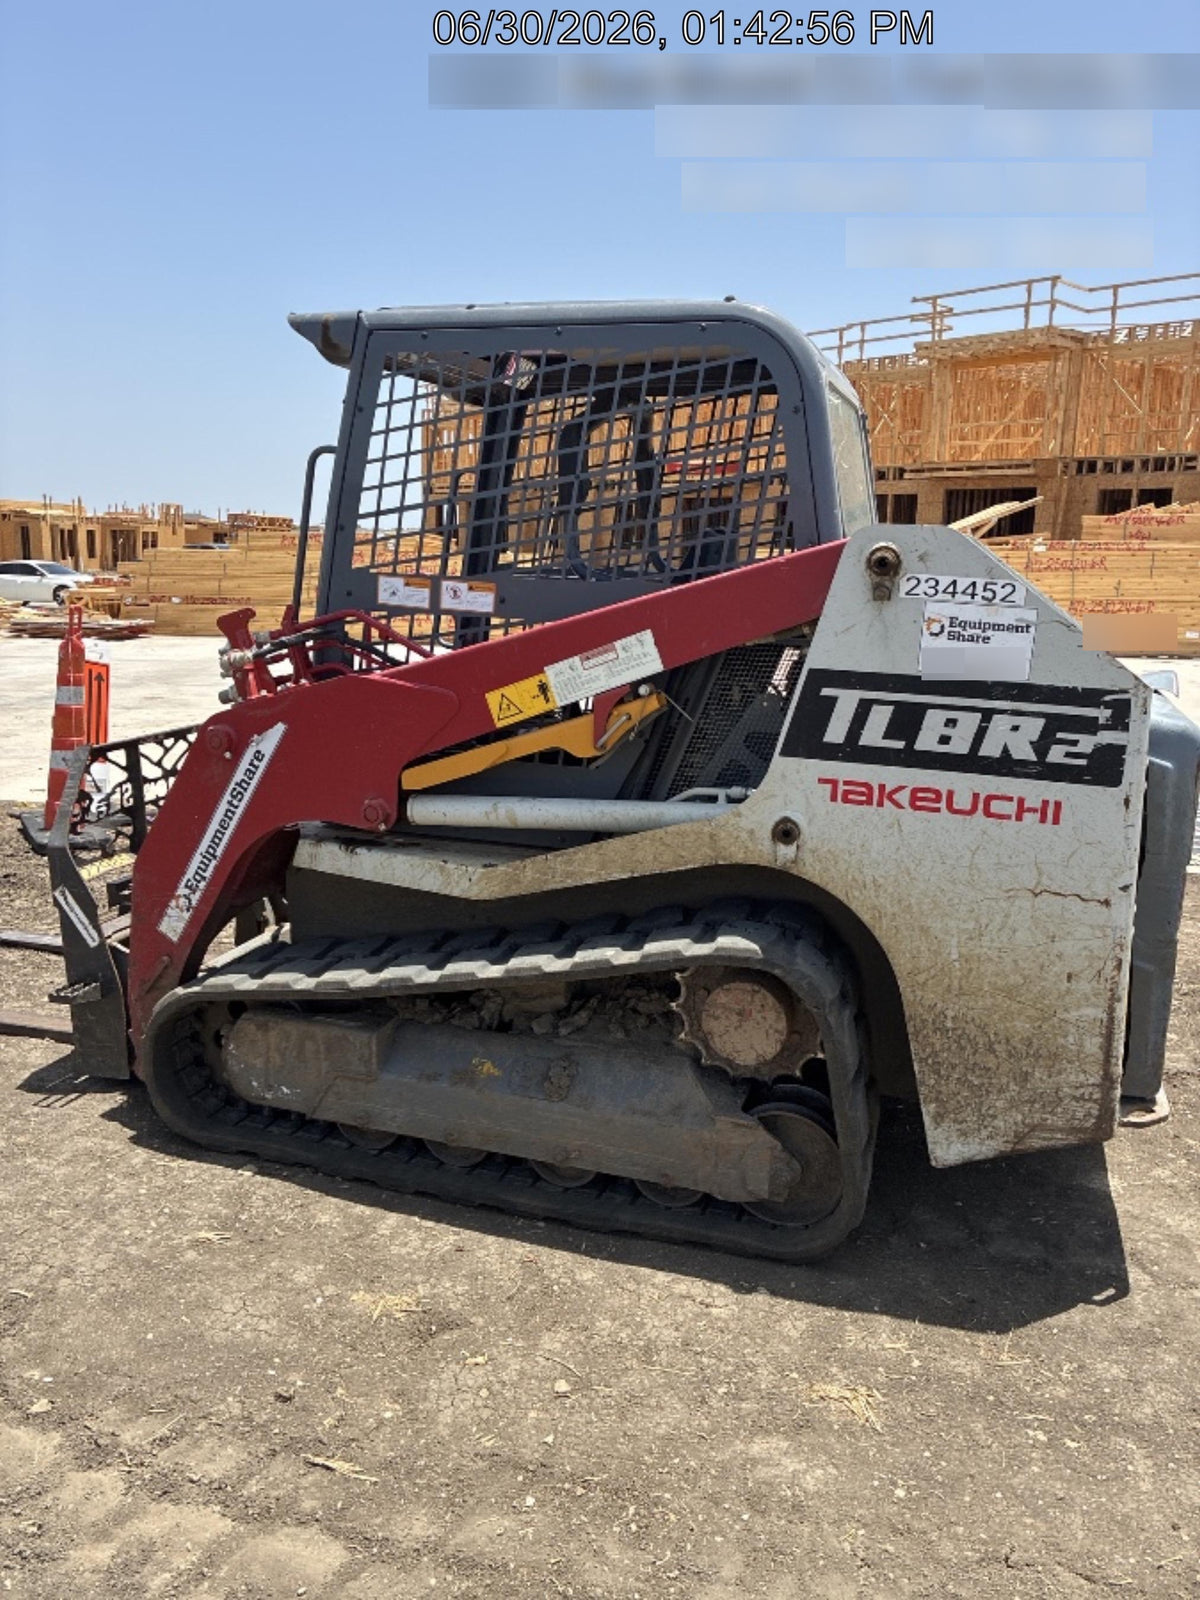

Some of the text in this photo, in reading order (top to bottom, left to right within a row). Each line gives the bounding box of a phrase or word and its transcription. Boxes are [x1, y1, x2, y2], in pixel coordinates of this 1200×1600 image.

[904, 575, 1017, 603] 234452
[948, 616, 1032, 634] Equipment
[947, 630, 991, 645] Share
[186, 748, 265, 895] EquipmentShare
